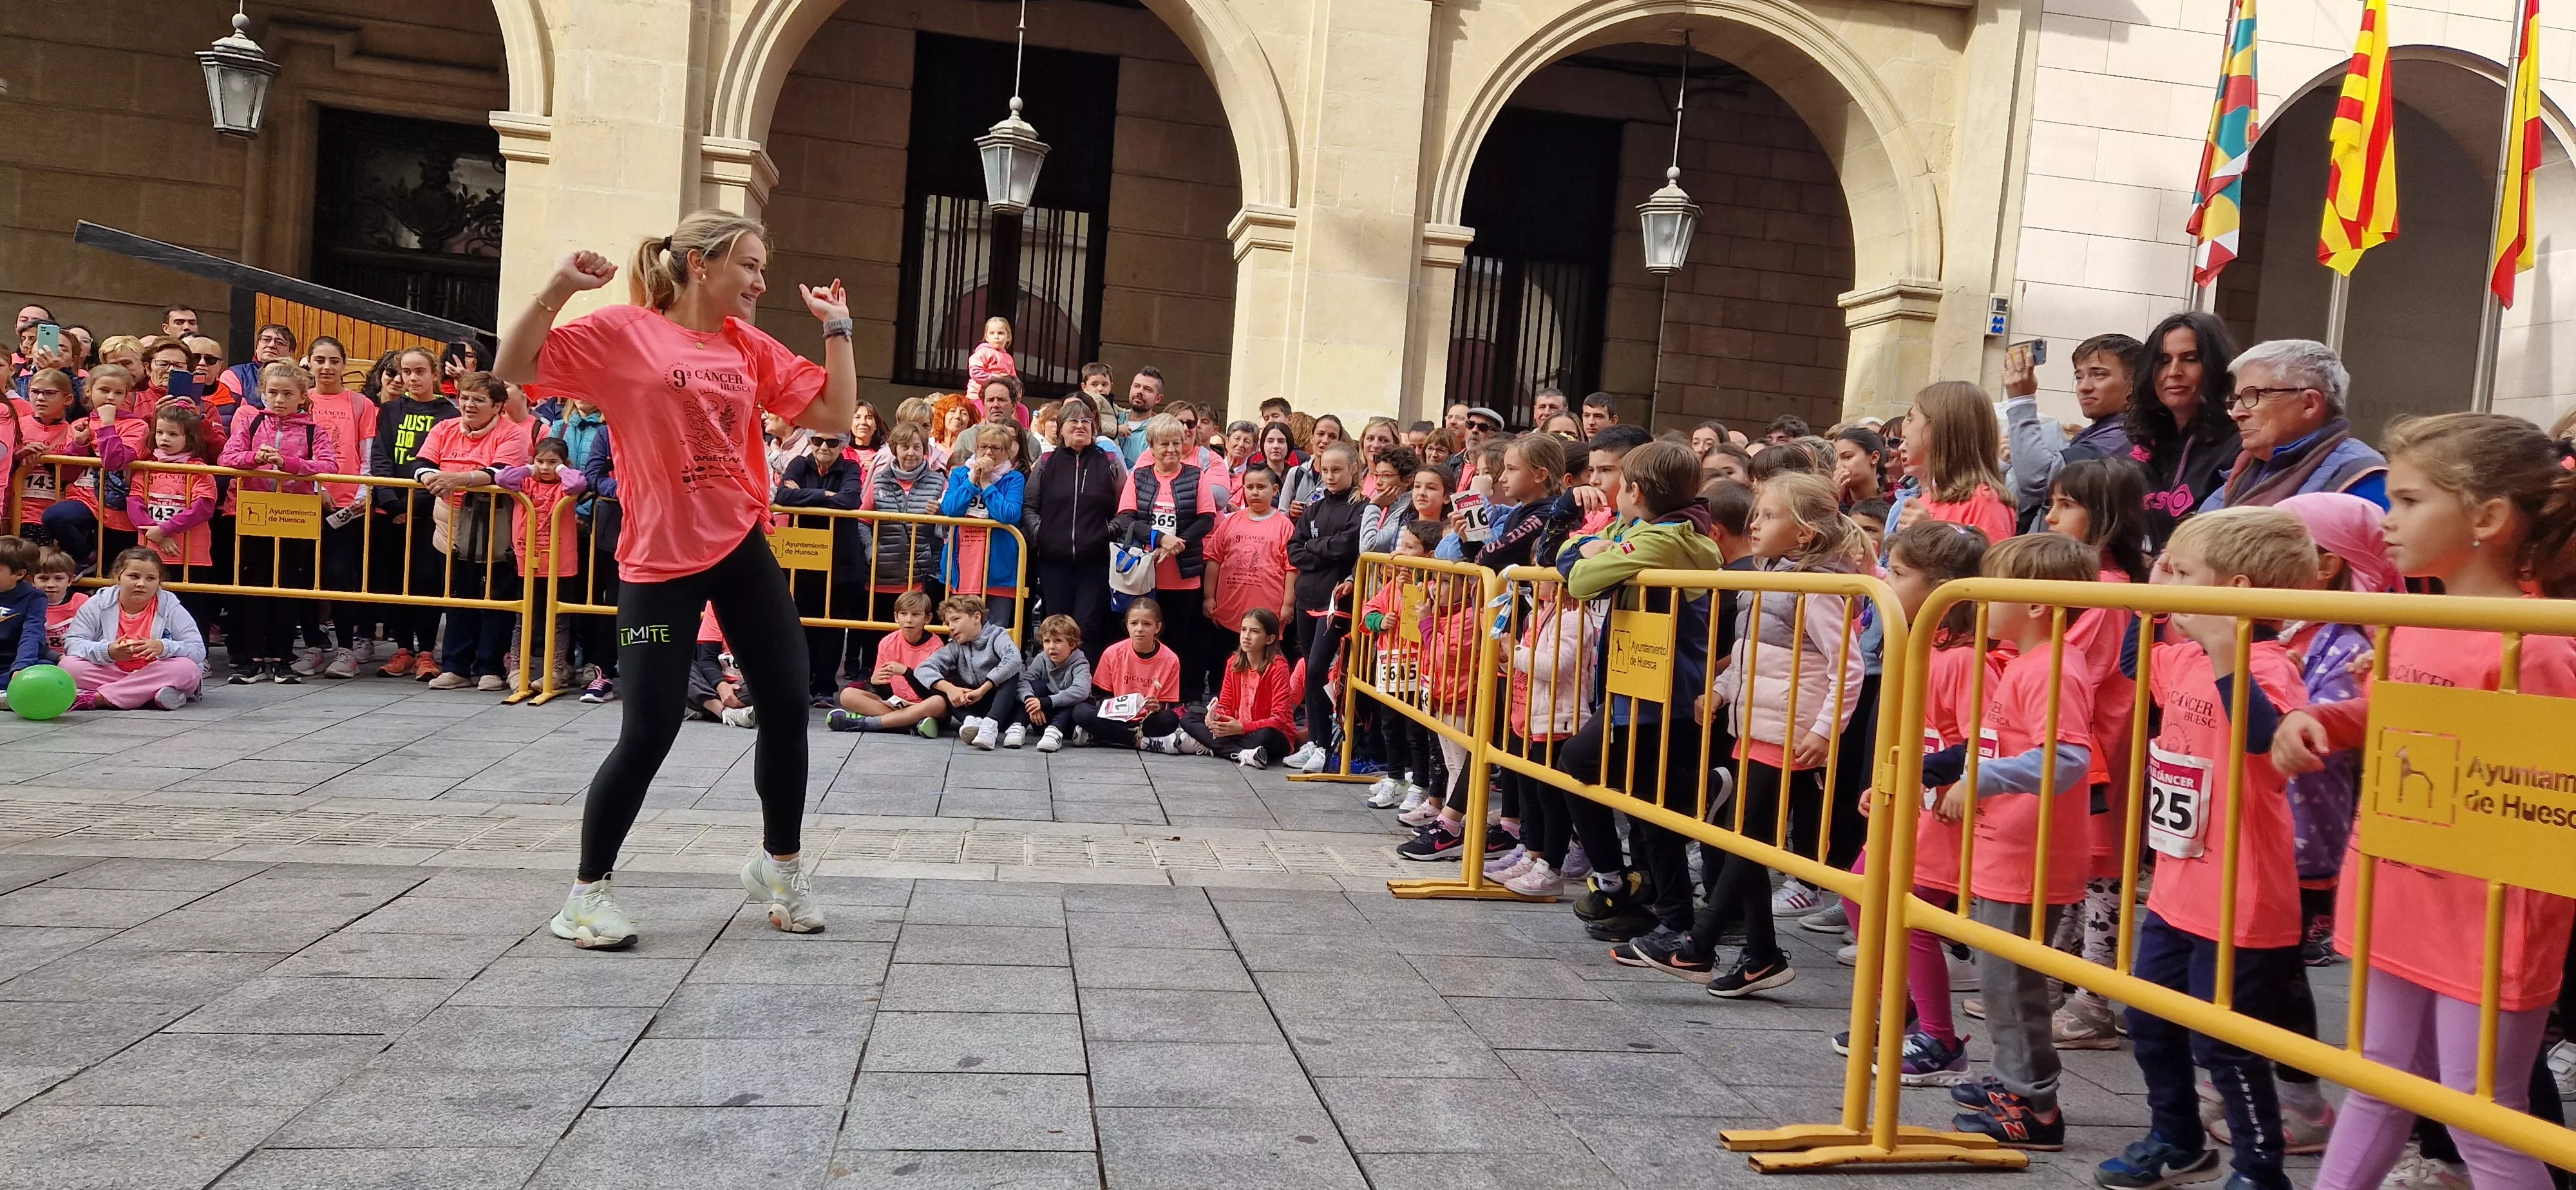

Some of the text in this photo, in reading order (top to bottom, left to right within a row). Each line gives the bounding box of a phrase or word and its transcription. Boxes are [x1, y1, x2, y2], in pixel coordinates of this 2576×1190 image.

[695, 369, 744, 384] CÁNCER
[721, 383, 751, 393] HUESCA
[398, 414, 435, 432] JUST
[395, 430, 415, 448] DO
[394, 447, 408, 465] IT
[269, 507, 316, 516] Ayuntamiento
[785, 541, 829, 549] Ayuntamiento
[1631, 640, 1667, 656] Ayuntamiento
[1629, 655, 1657, 670] de Huesca
[2184, 712, 2217, 729] HUESC
[2157, 770, 2194, 788] CÁNCER
[2465, 789, 2495, 815] de
